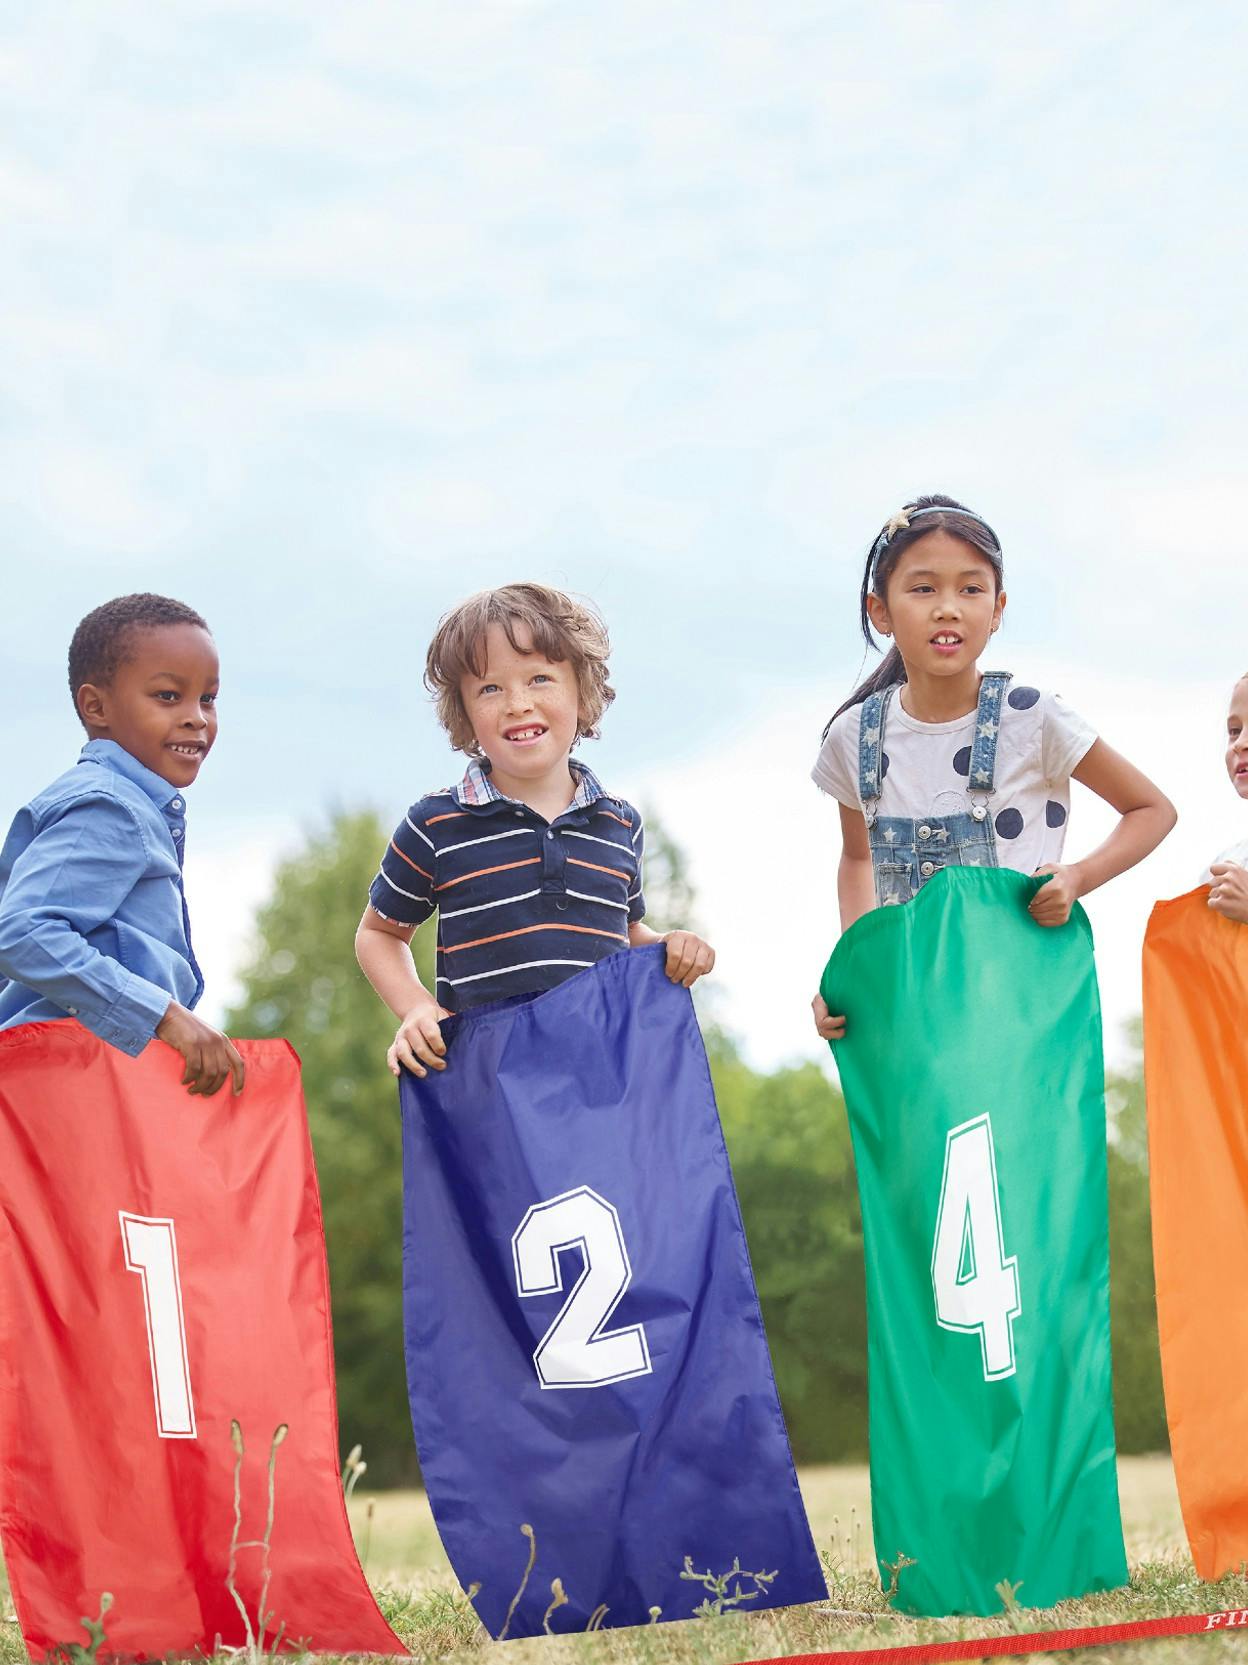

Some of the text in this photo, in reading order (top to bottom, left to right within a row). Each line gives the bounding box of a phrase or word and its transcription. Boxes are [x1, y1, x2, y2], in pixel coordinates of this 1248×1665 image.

[118, 1210, 198, 1439] 1
[511, 1185, 653, 1389] 2
[930, 1111, 1022, 1382] 4
